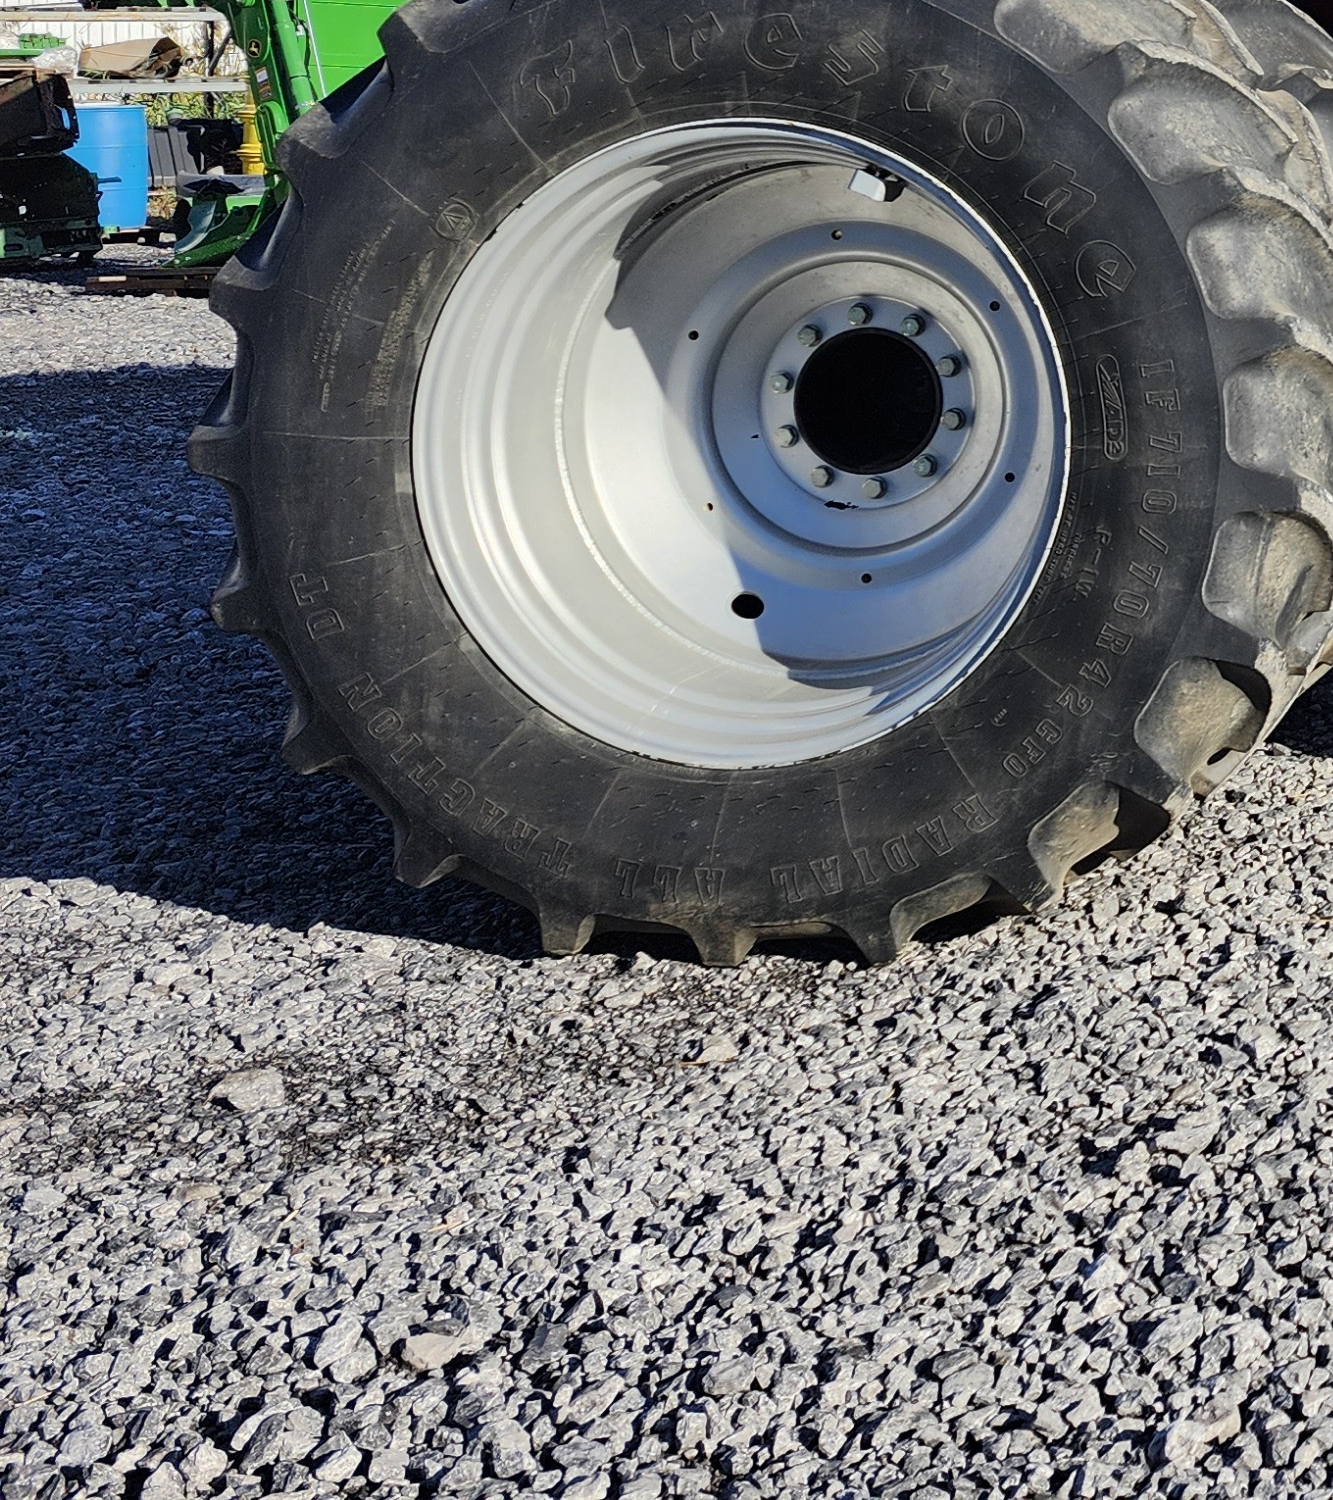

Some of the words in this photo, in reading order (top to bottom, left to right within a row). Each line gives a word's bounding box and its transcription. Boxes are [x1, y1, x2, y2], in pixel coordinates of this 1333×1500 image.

[520, 12, 1138, 301] Firestone
[1140, 360, 1179, 413] IF
[292, 568, 346, 642] DT
[1057, 433, 1179, 719] 710/70R42
[1075, 527, 1112, 599] R-1W
[339, 672, 574, 878] TRACTION
[614, 854, 723, 910] ALL
[771, 795, 993, 902] RADIAL
